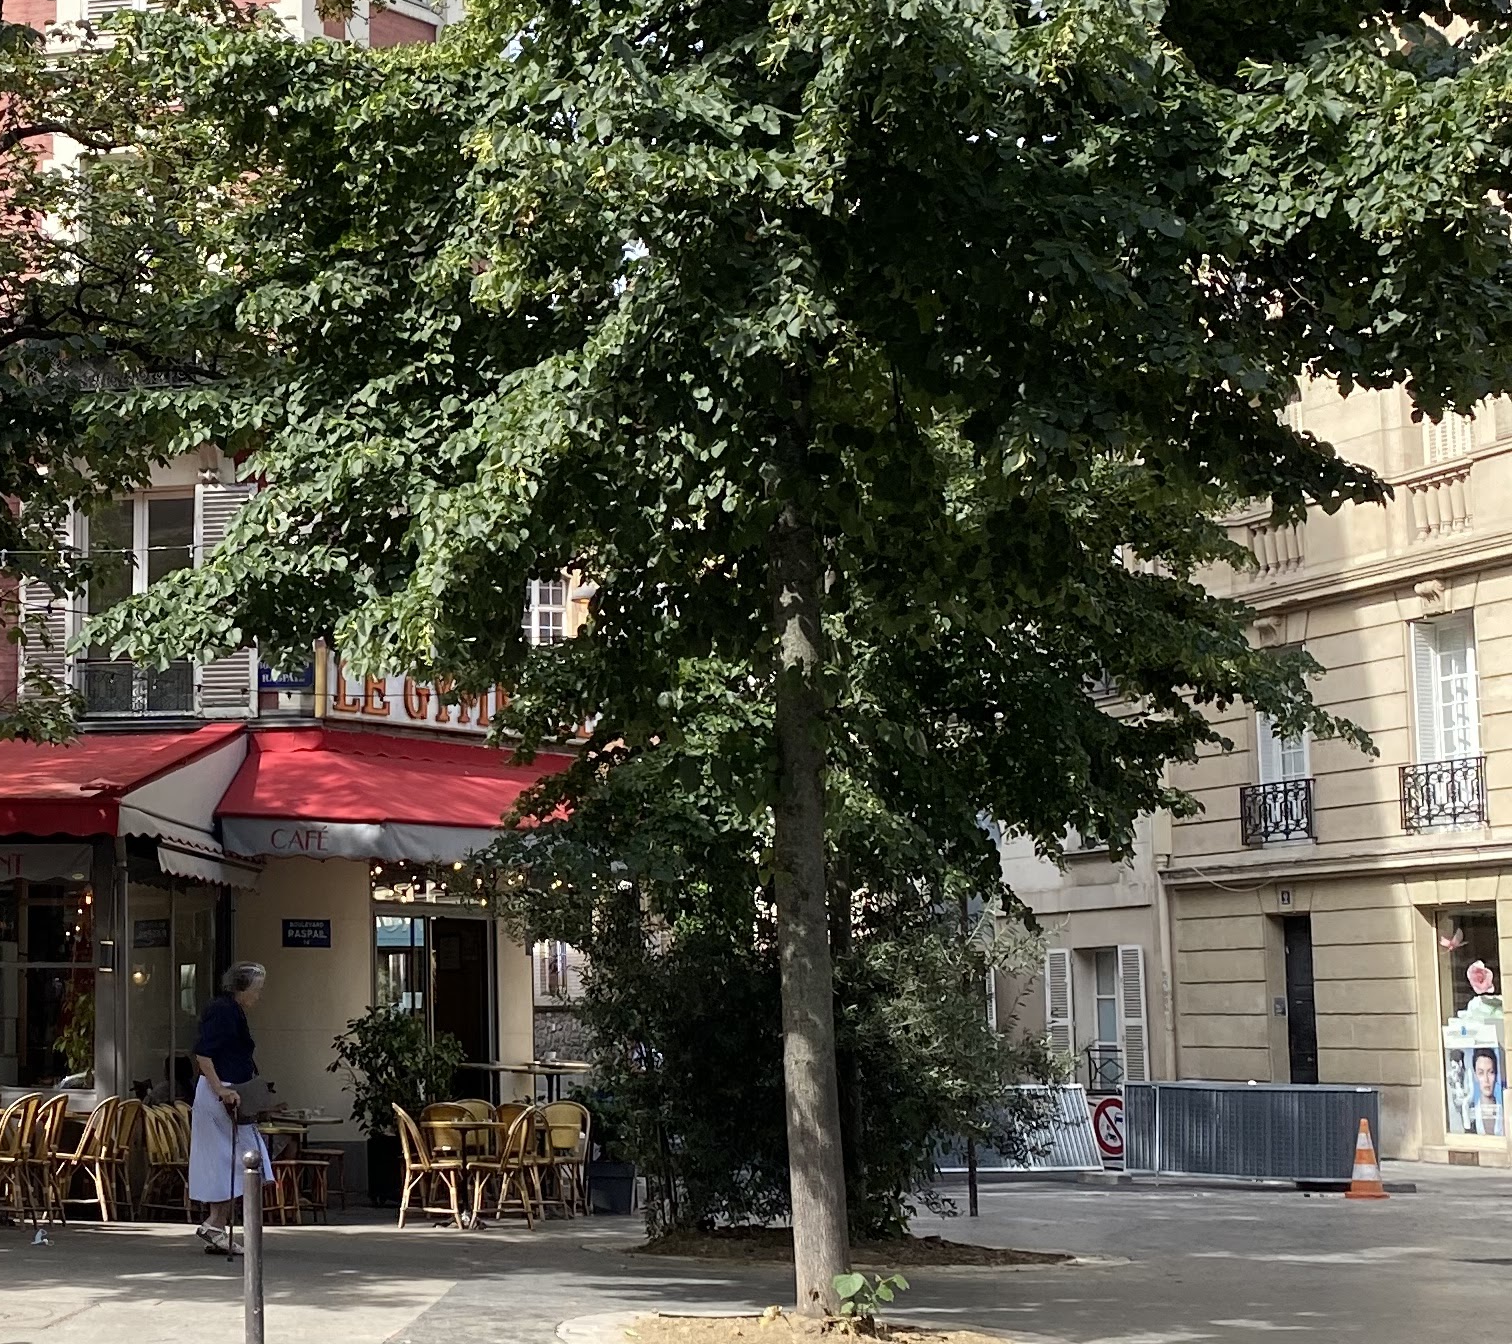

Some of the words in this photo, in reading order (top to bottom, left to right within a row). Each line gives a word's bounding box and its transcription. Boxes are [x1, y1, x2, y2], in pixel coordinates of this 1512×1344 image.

[333, 659, 391, 717] LE
[271, 825, 328, 851] CAFÉ
[287, 929, 328, 938] RASPAIL
